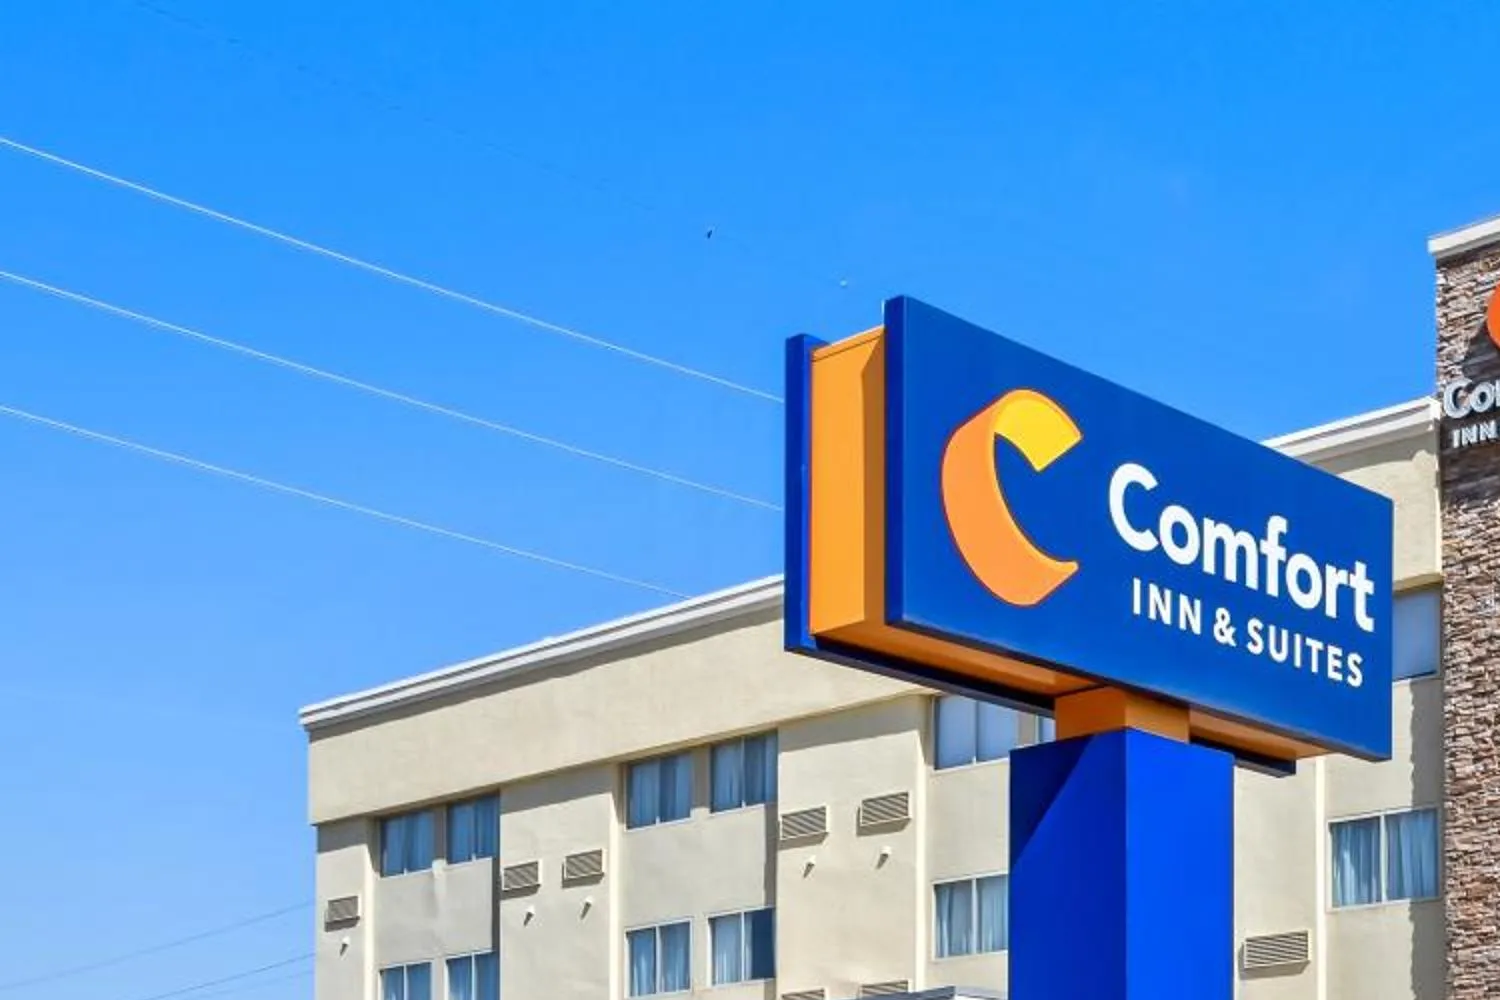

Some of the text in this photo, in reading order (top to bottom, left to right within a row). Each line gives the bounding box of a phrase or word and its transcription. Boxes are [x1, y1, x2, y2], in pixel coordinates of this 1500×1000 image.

[1453, 419, 1497, 448] INN
[1109, 463, 1374, 632] Comfort
[1132, 577, 1363, 688] INN & SUITES
